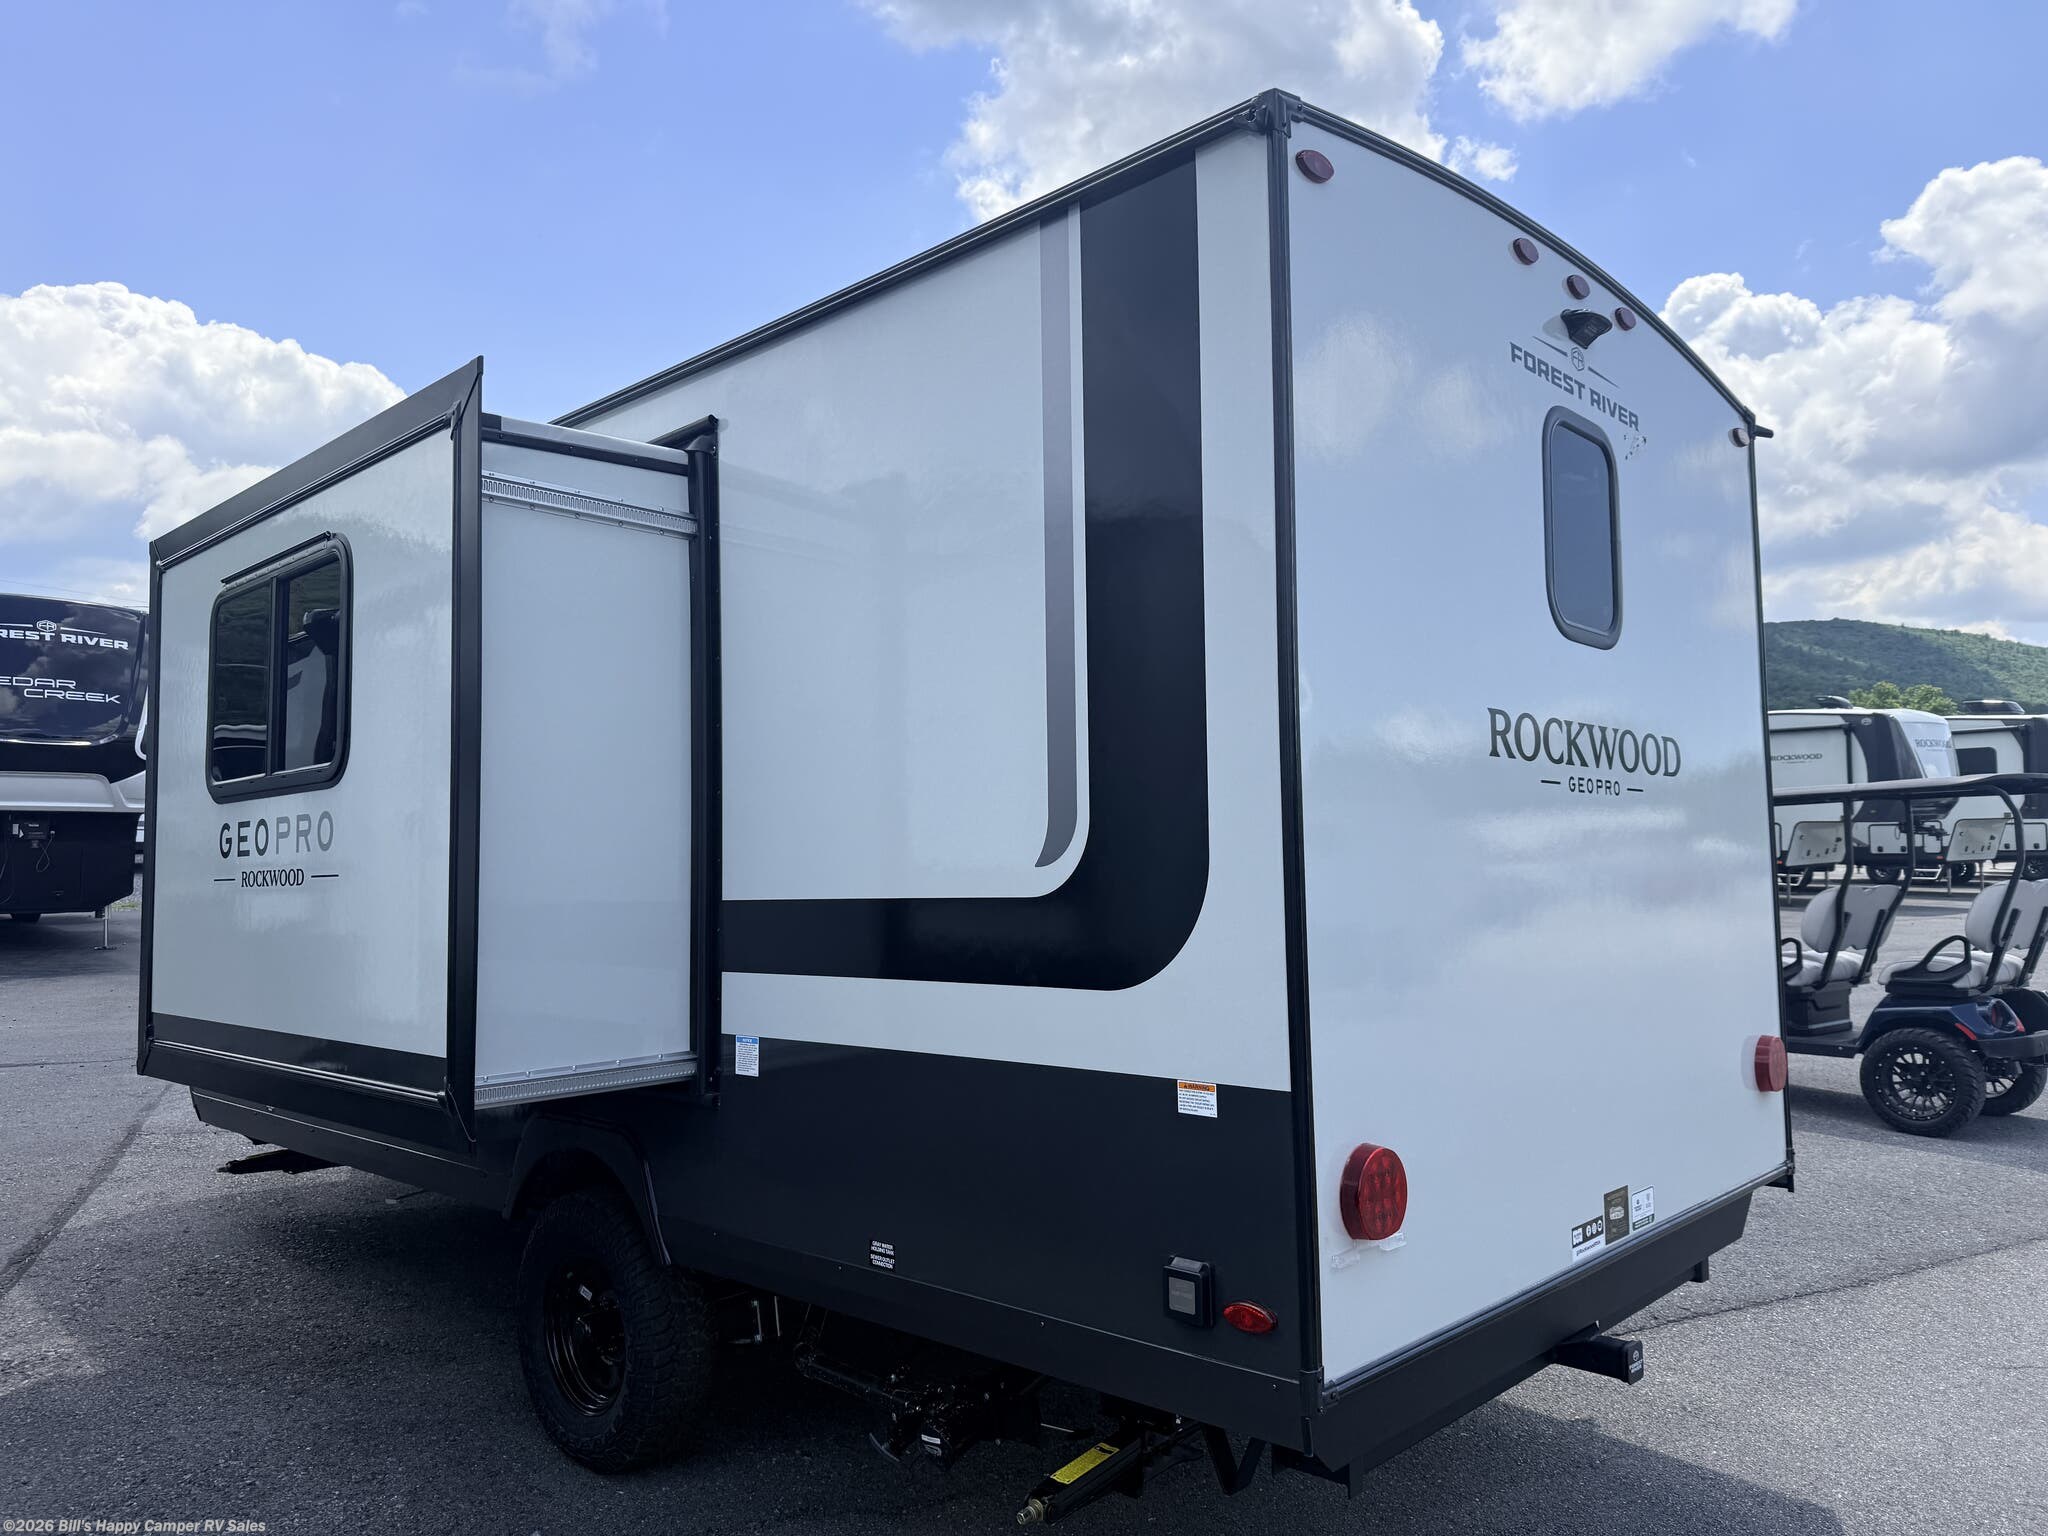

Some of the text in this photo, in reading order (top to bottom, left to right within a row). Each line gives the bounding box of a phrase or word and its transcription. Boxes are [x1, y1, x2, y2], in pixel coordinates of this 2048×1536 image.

[1509, 341, 1639, 432] FOREST RIVER
[60, 633, 129, 650] RIVER
[24, 688, 121, 704] CREEK
[1487, 707, 1681, 777] ROCKWOOD
[1568, 776, 1621, 796] GEOPRO
[219, 811, 334, 859] GEOPRO
[241, 868, 304, 887] ROCKWOOD
